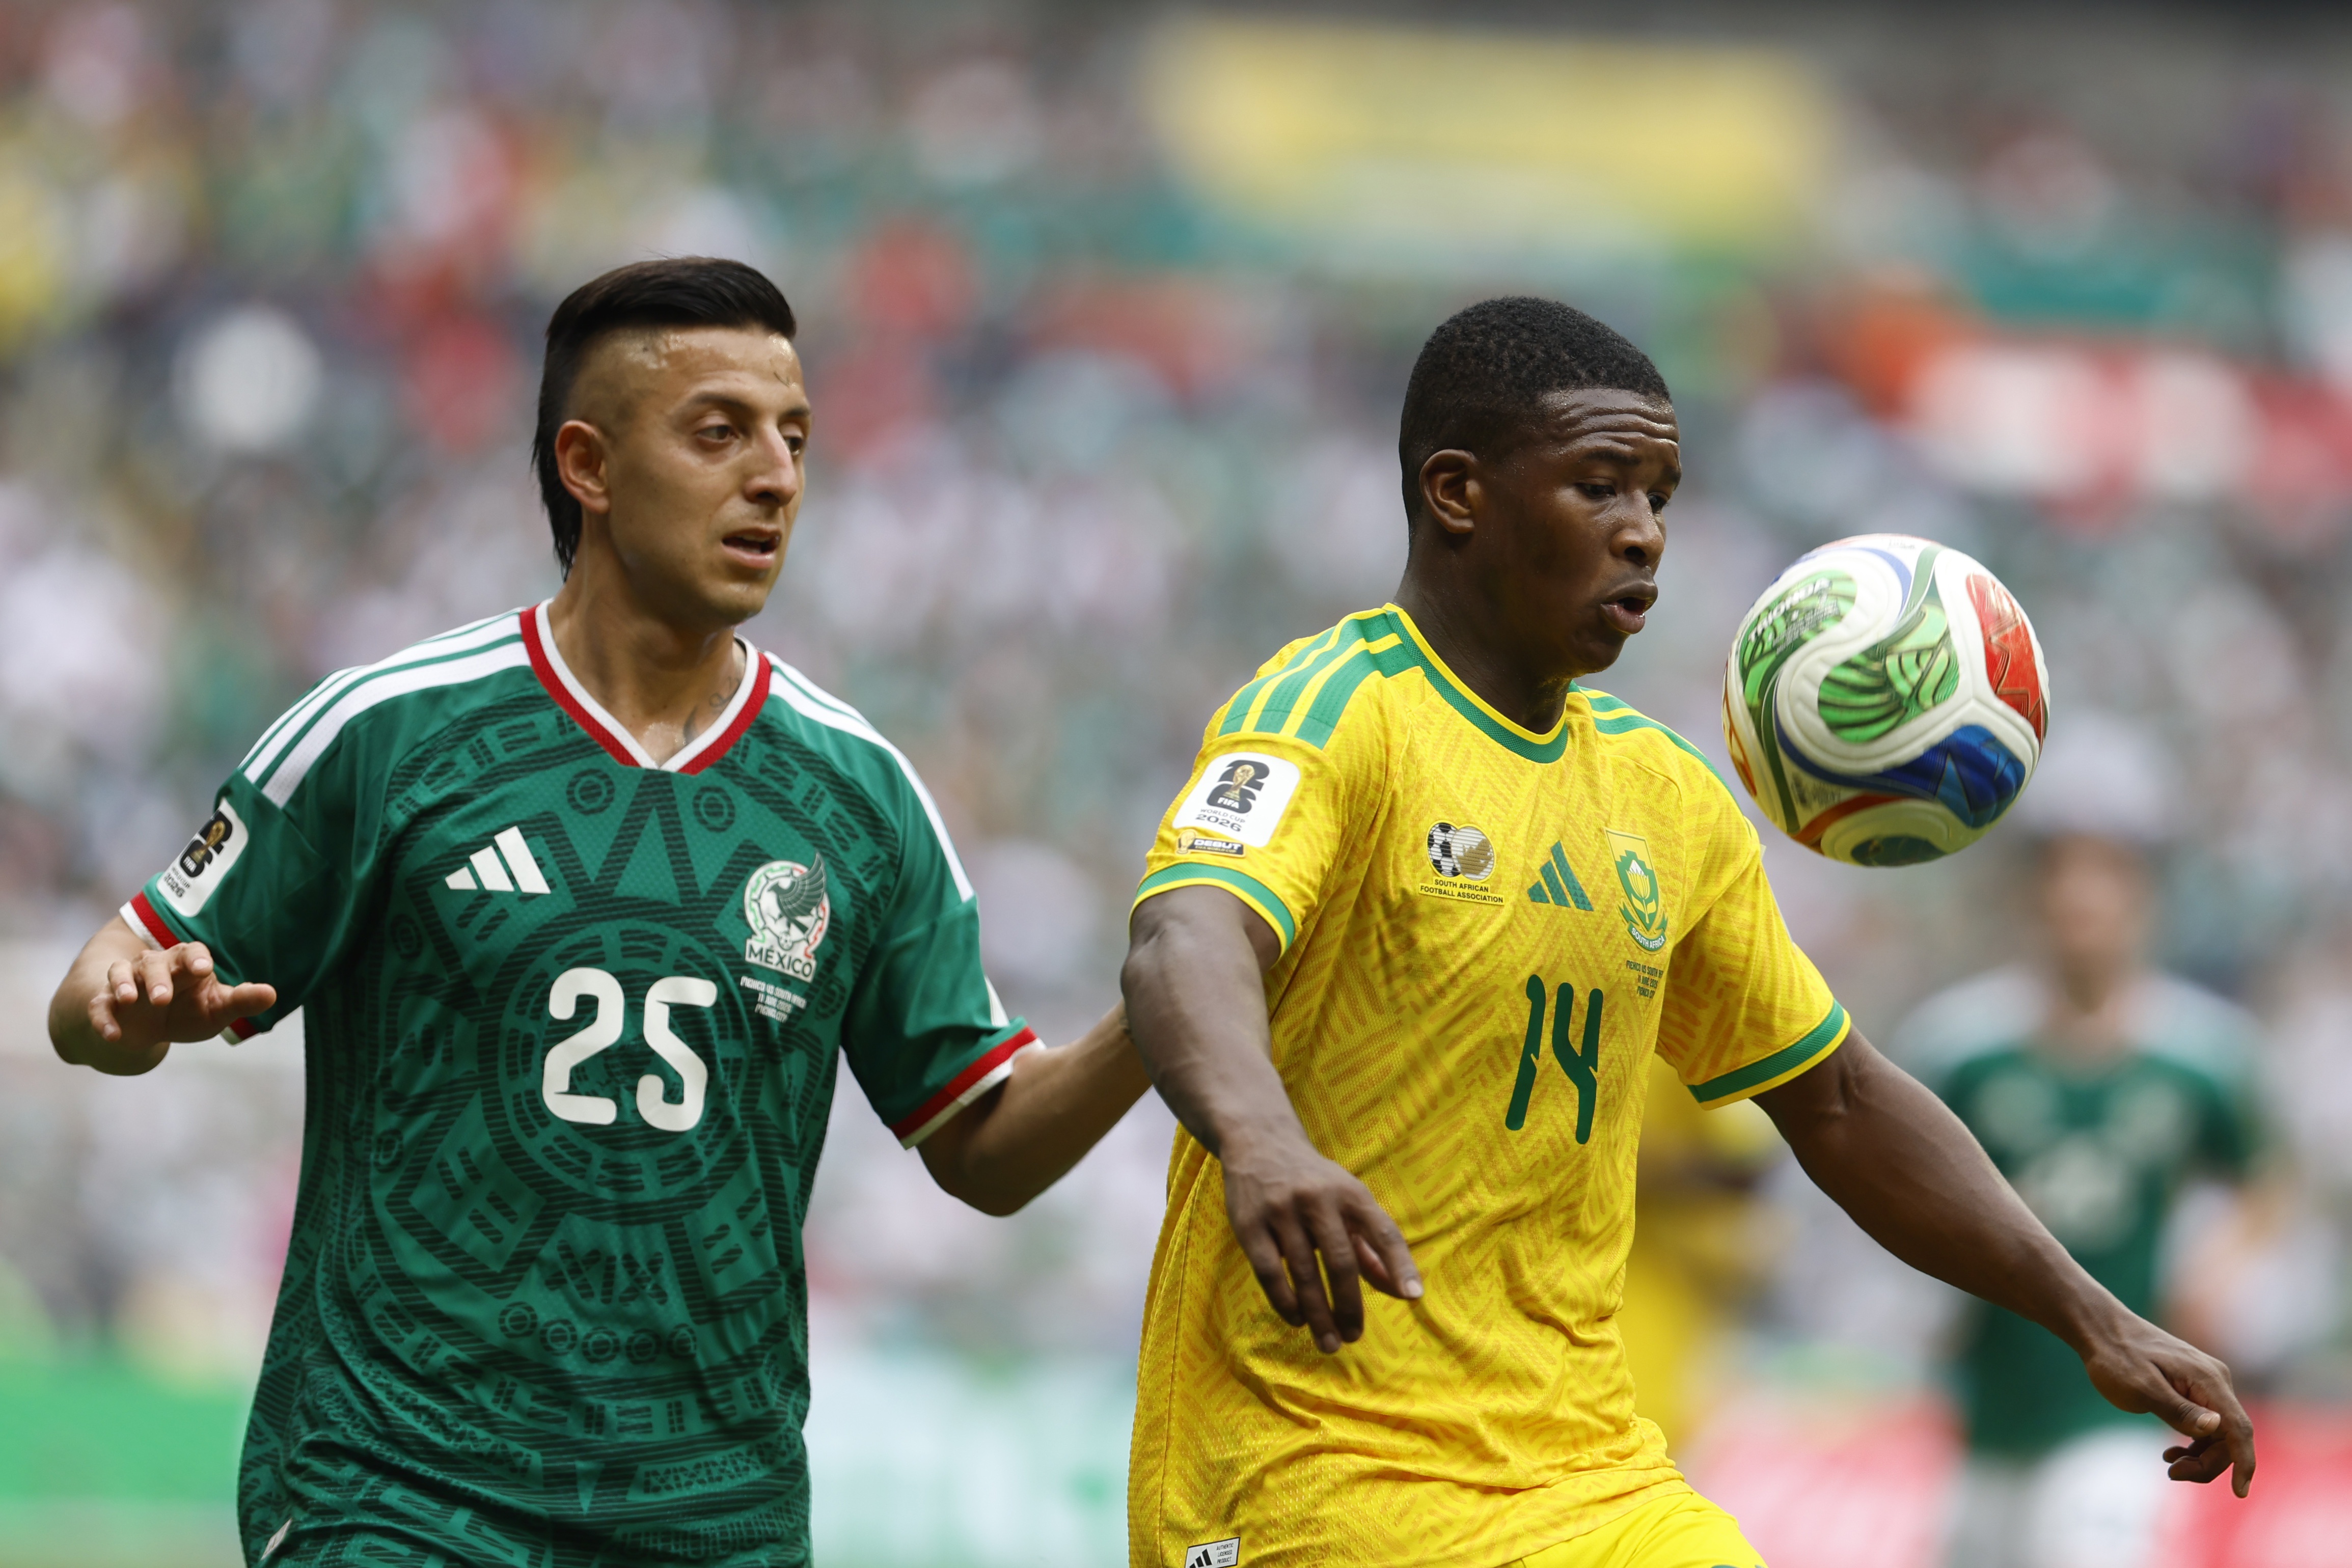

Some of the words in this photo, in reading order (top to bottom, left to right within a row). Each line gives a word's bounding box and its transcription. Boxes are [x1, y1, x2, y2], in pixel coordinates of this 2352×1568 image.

[1217, 797, 1239, 809] FIFA
[1195, 814, 1242, 832] 2026
[1200, 809, 1228, 817] WORLD
[1229, 815, 1245, 823] CUP
[1194, 839, 1241, 850] DEBUT
[164, 873, 185, 897] 2026
[1420, 885, 1455, 897] FOOTBALL
[1457, 892, 1503, 903] ASSOCIATION
[1435, 879, 1457, 888] SOUTH
[1459, 883, 1489, 892] AFRICAN
[1631, 927, 1649, 947] SOUTH
[1650, 935, 1664, 949] AFRICA
[747, 945, 812, 977] MÉXICO
[1626, 960, 1640, 971] MEXICO
[1647, 966, 1658, 977] SOUTH
[740, 976, 766, 993] MEXICO
[774, 987, 792, 1002] SOUTH
[542, 967, 718, 1132] 25
[1506, 974, 1603, 1144] 14
